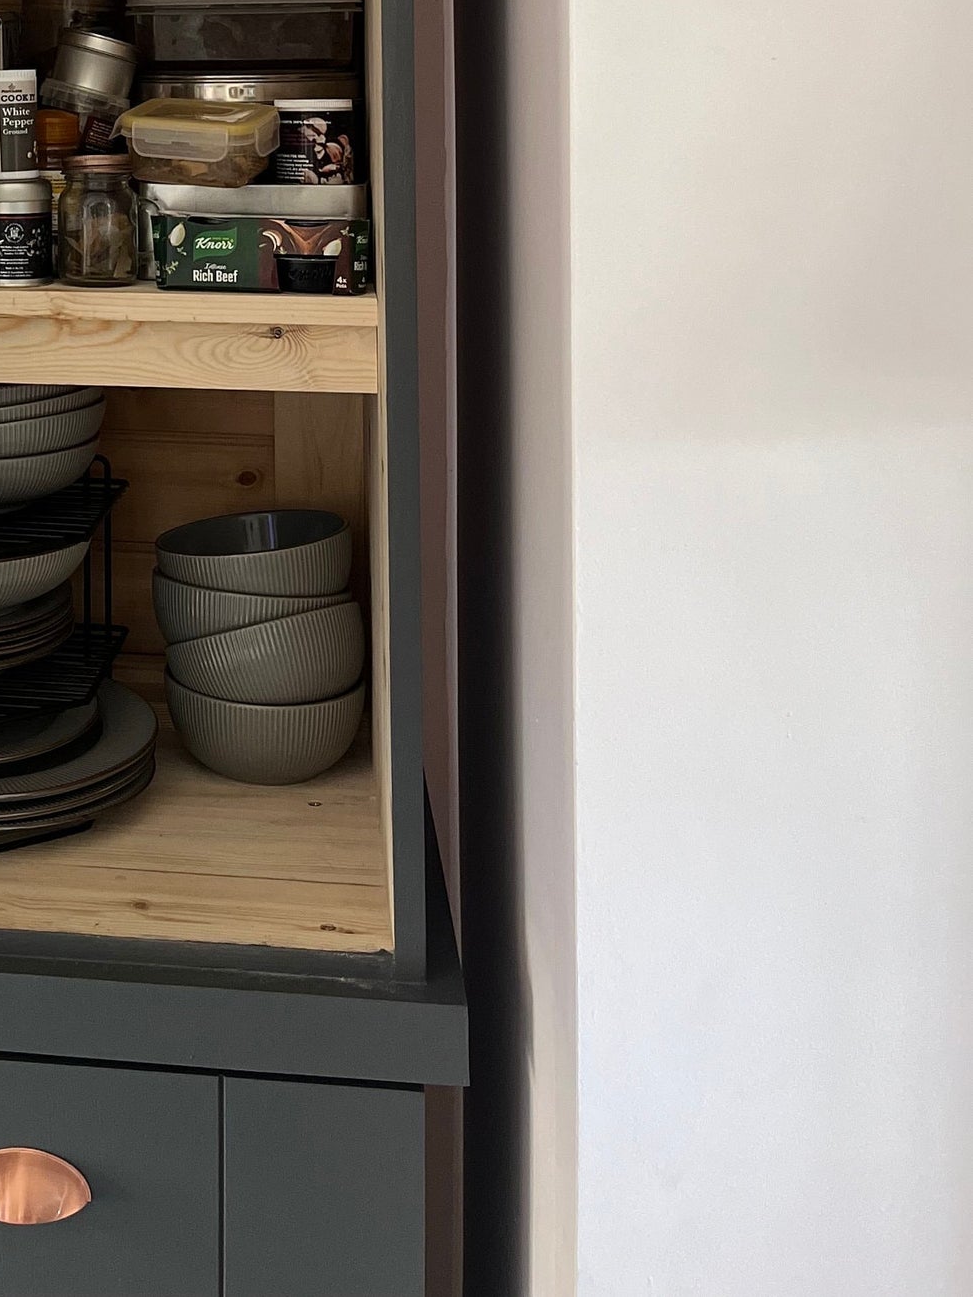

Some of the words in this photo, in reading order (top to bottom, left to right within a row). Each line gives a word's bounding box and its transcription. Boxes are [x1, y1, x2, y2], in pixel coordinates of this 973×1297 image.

[1, 94, 29, 102] COOK
[2, 106, 31, 116] White
[3, 117, 35, 128] Pepper
[195, 237, 235, 250] Knorr
[193, 269, 213, 282] Rich
[216, 270, 239, 283] Beef
[337, 276, 347, 284] 4x
